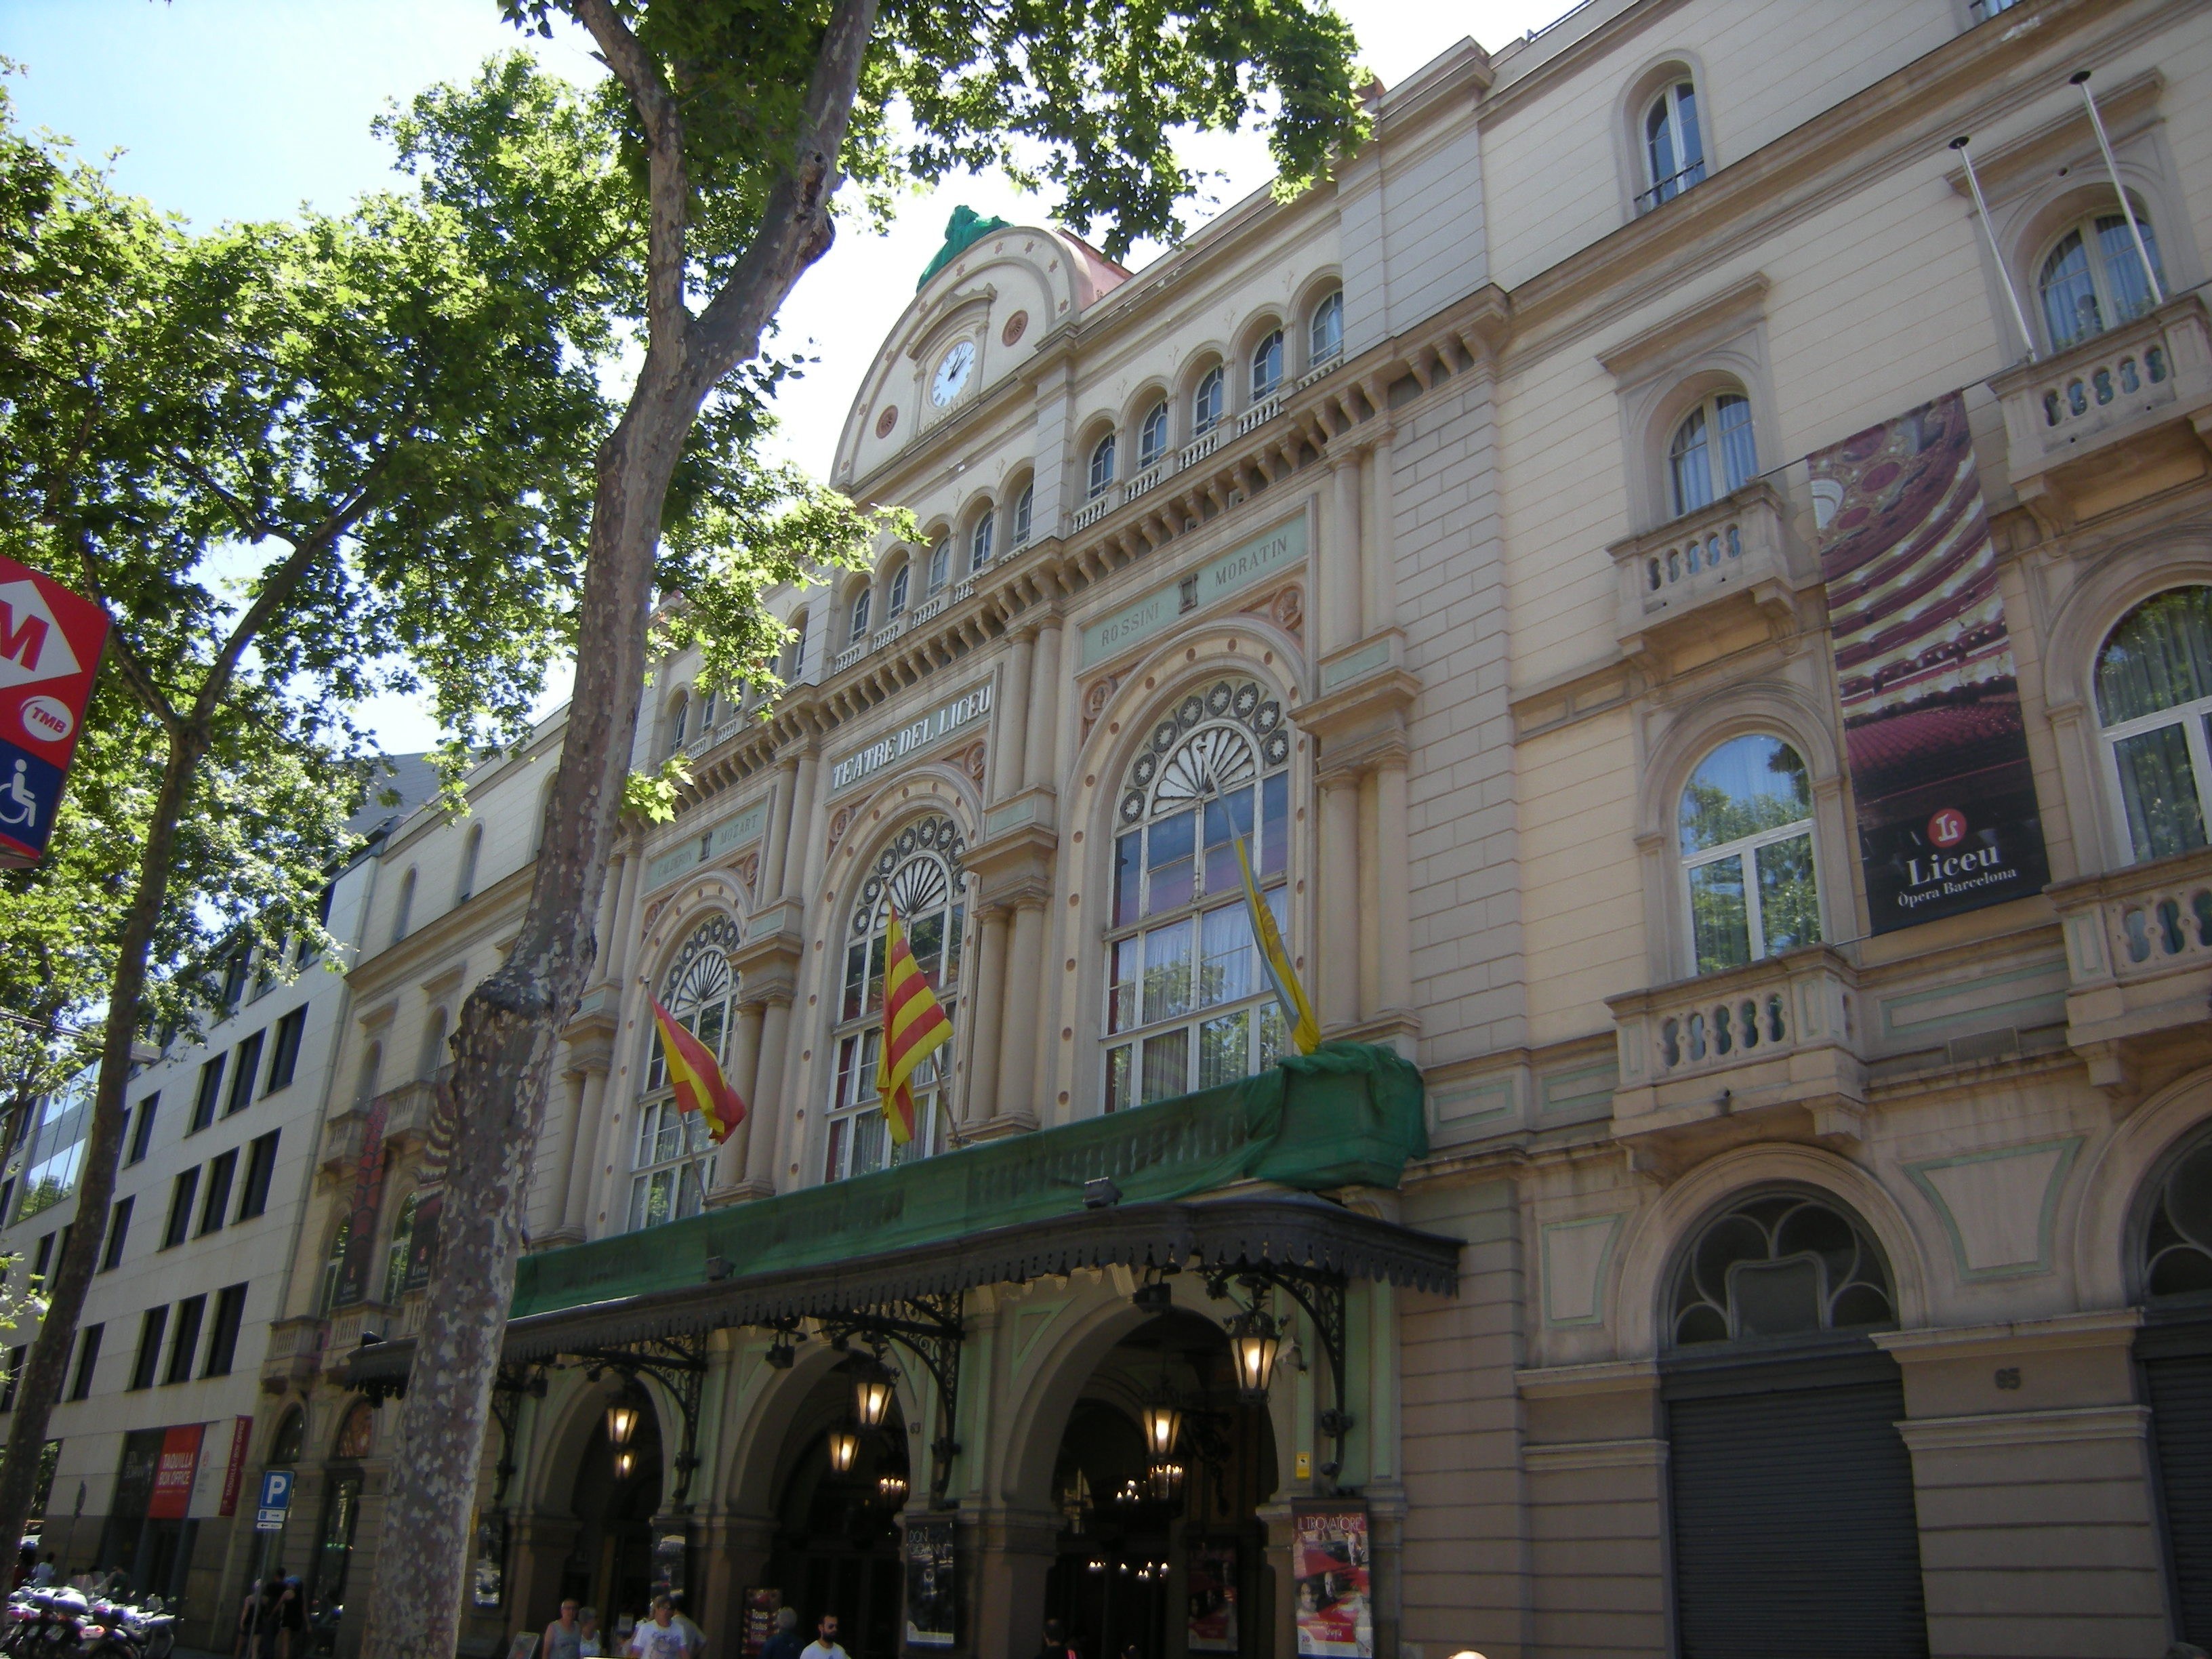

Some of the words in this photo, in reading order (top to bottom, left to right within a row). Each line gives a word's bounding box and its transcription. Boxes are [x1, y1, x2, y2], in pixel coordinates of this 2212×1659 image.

[1215, 536, 1287, 587] MORATIN
[1101, 602, 1159, 646] ROSSINI
[31, 705, 67, 734] TMB
[834, 735, 897, 790] TEATRE
[899, 718, 934, 757] DEL
[939, 685, 991, 736] LICEU
[720, 814, 758, 845] MOZART
[1907, 845, 2000, 886] Liceu
[1898, 889, 1940, 907] Òpera
[1943, 868, 2017, 895] Barcelona
[163, 1452, 193, 1469] TAQUILLA
[159, 1471, 170, 1486] BOX
[171, 1470, 191, 1485] OFFICE
[267, 1475, 286, 1503] P
[1298, 1517, 1304, 1530] IL
[1306, 1517, 1361, 1530] TROVATORE
